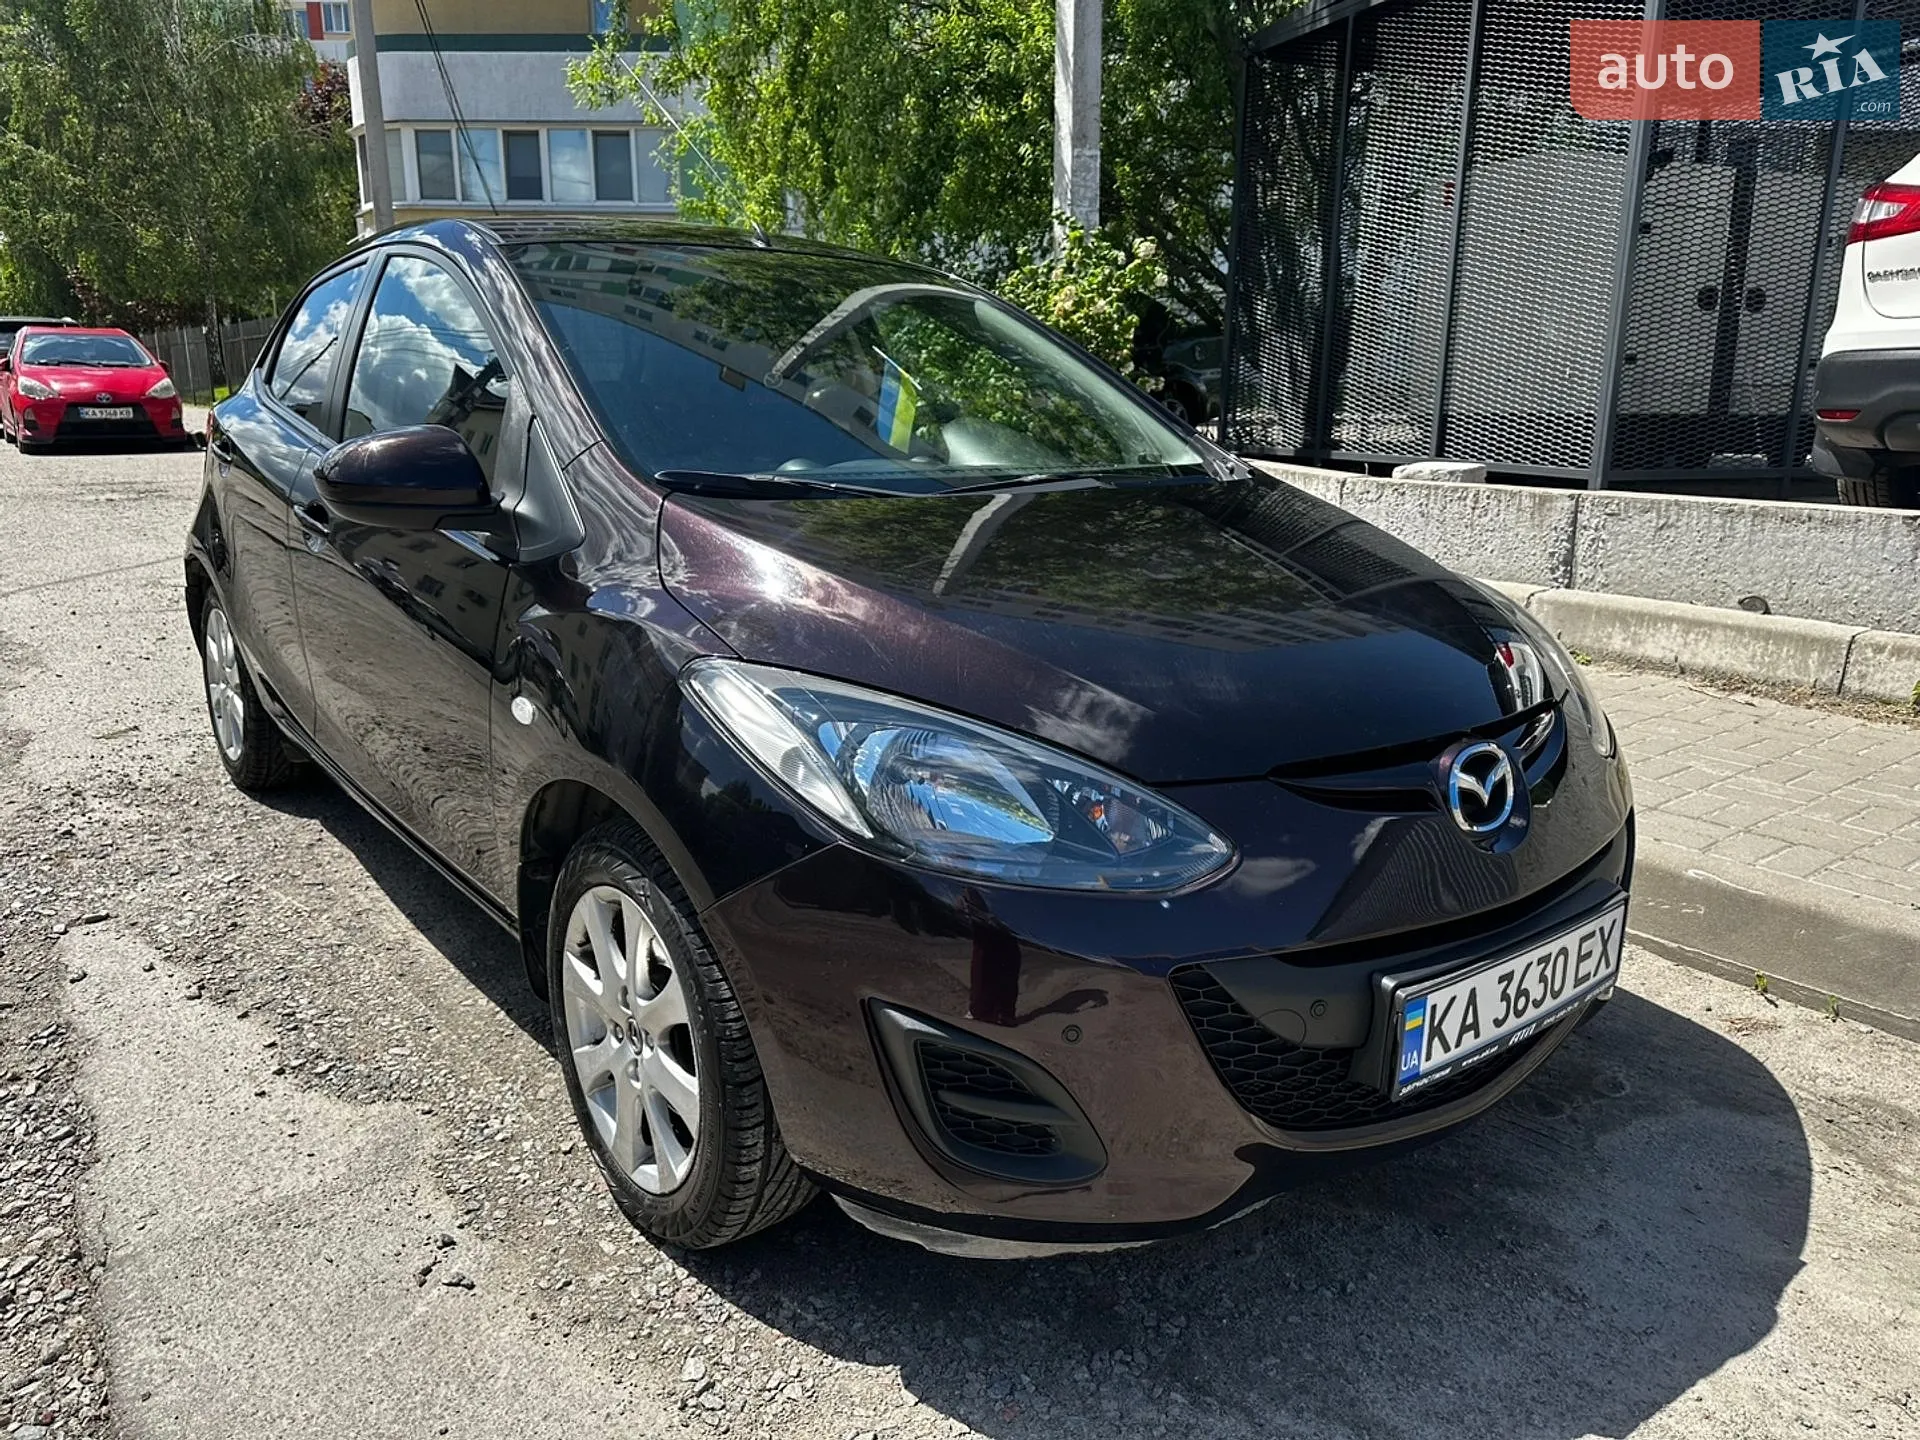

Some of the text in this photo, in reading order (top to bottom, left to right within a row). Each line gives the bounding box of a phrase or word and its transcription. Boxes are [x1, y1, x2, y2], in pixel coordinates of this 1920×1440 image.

[1425, 918, 1618, 1062] KA 3630 EX
[1401, 1049, 1419, 1071] UA
